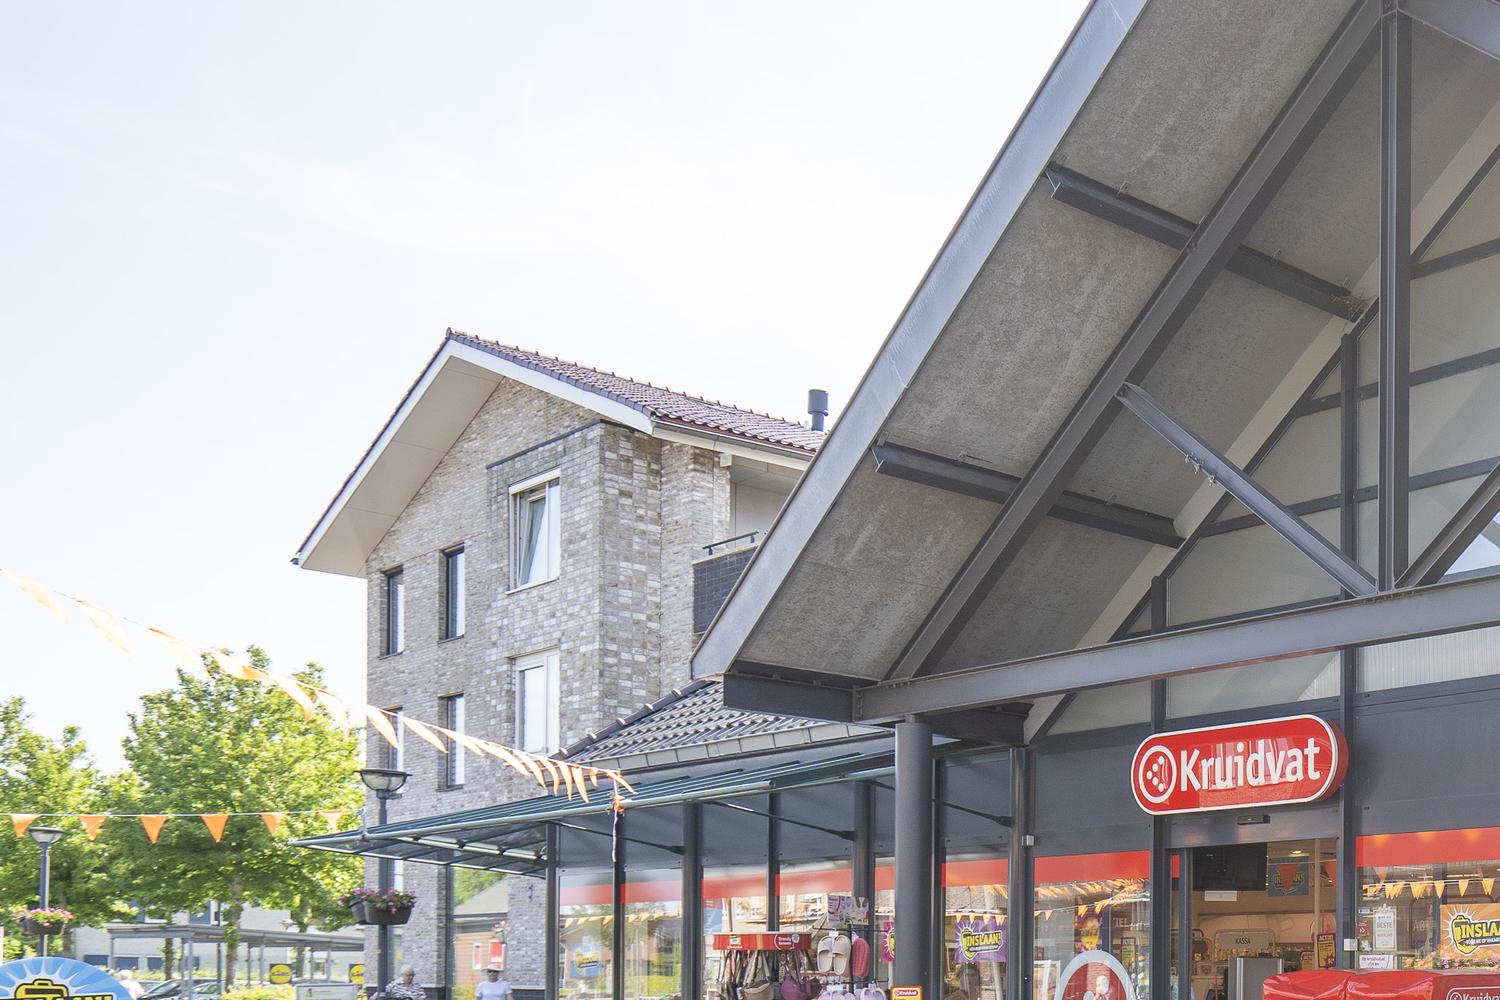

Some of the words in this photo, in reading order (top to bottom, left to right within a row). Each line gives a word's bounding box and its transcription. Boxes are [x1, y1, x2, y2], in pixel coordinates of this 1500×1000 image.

[1180, 737, 1321, 792] Kruidvat
[1376, 921, 1393, 929] BESTE
[966, 932, 1001, 948] INSLAAN!
[1235, 936, 1251, 945] KASSA
